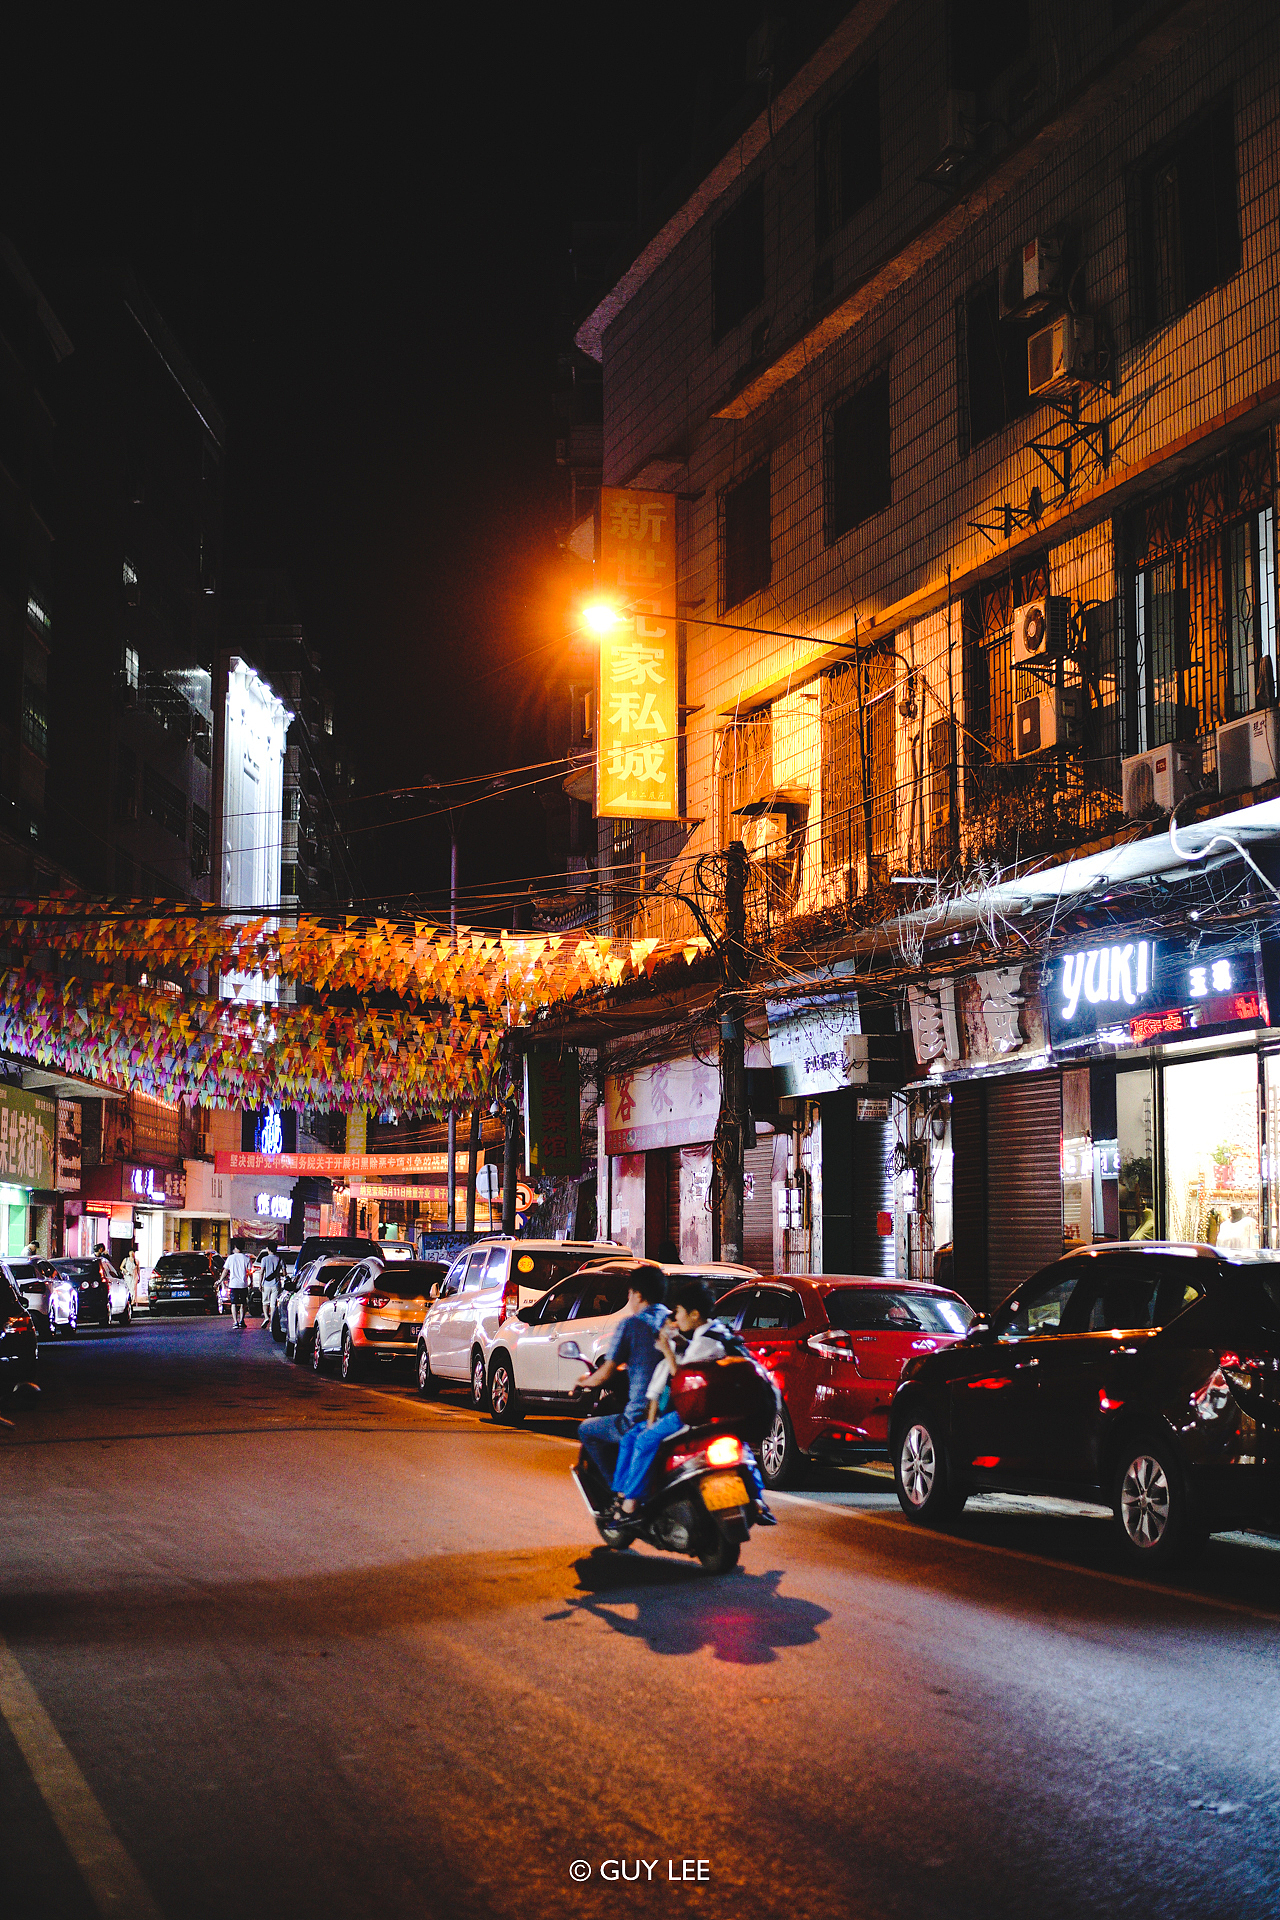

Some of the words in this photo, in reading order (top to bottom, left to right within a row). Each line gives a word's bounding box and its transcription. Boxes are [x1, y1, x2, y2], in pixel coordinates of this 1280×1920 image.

[607, 497, 668, 784] 新世纪家私城
[540, 1058, 568, 1158] 客家菜馆
